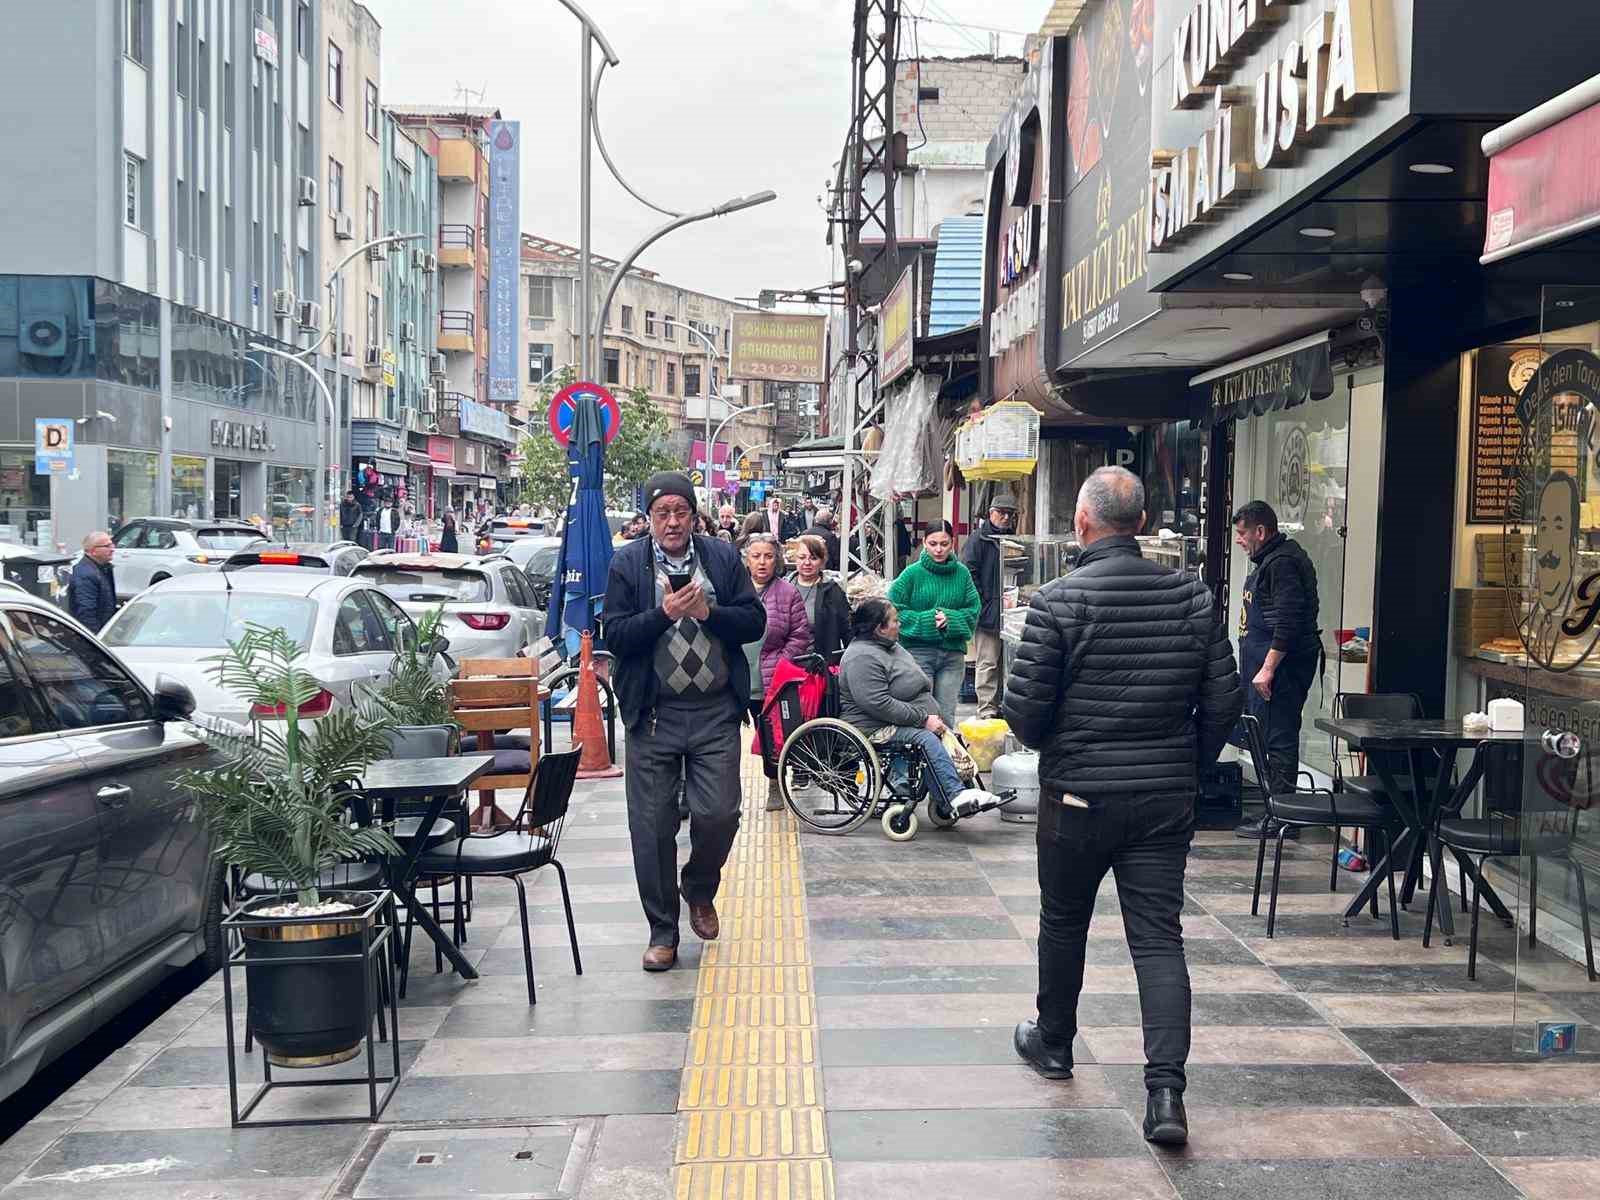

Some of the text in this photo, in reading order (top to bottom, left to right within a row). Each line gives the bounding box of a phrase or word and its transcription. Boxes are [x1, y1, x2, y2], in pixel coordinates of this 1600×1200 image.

[1254, 0, 1358, 169] USTA
[1062, 234, 1113, 331] TATLICI
[47, 427, 62, 447] D
